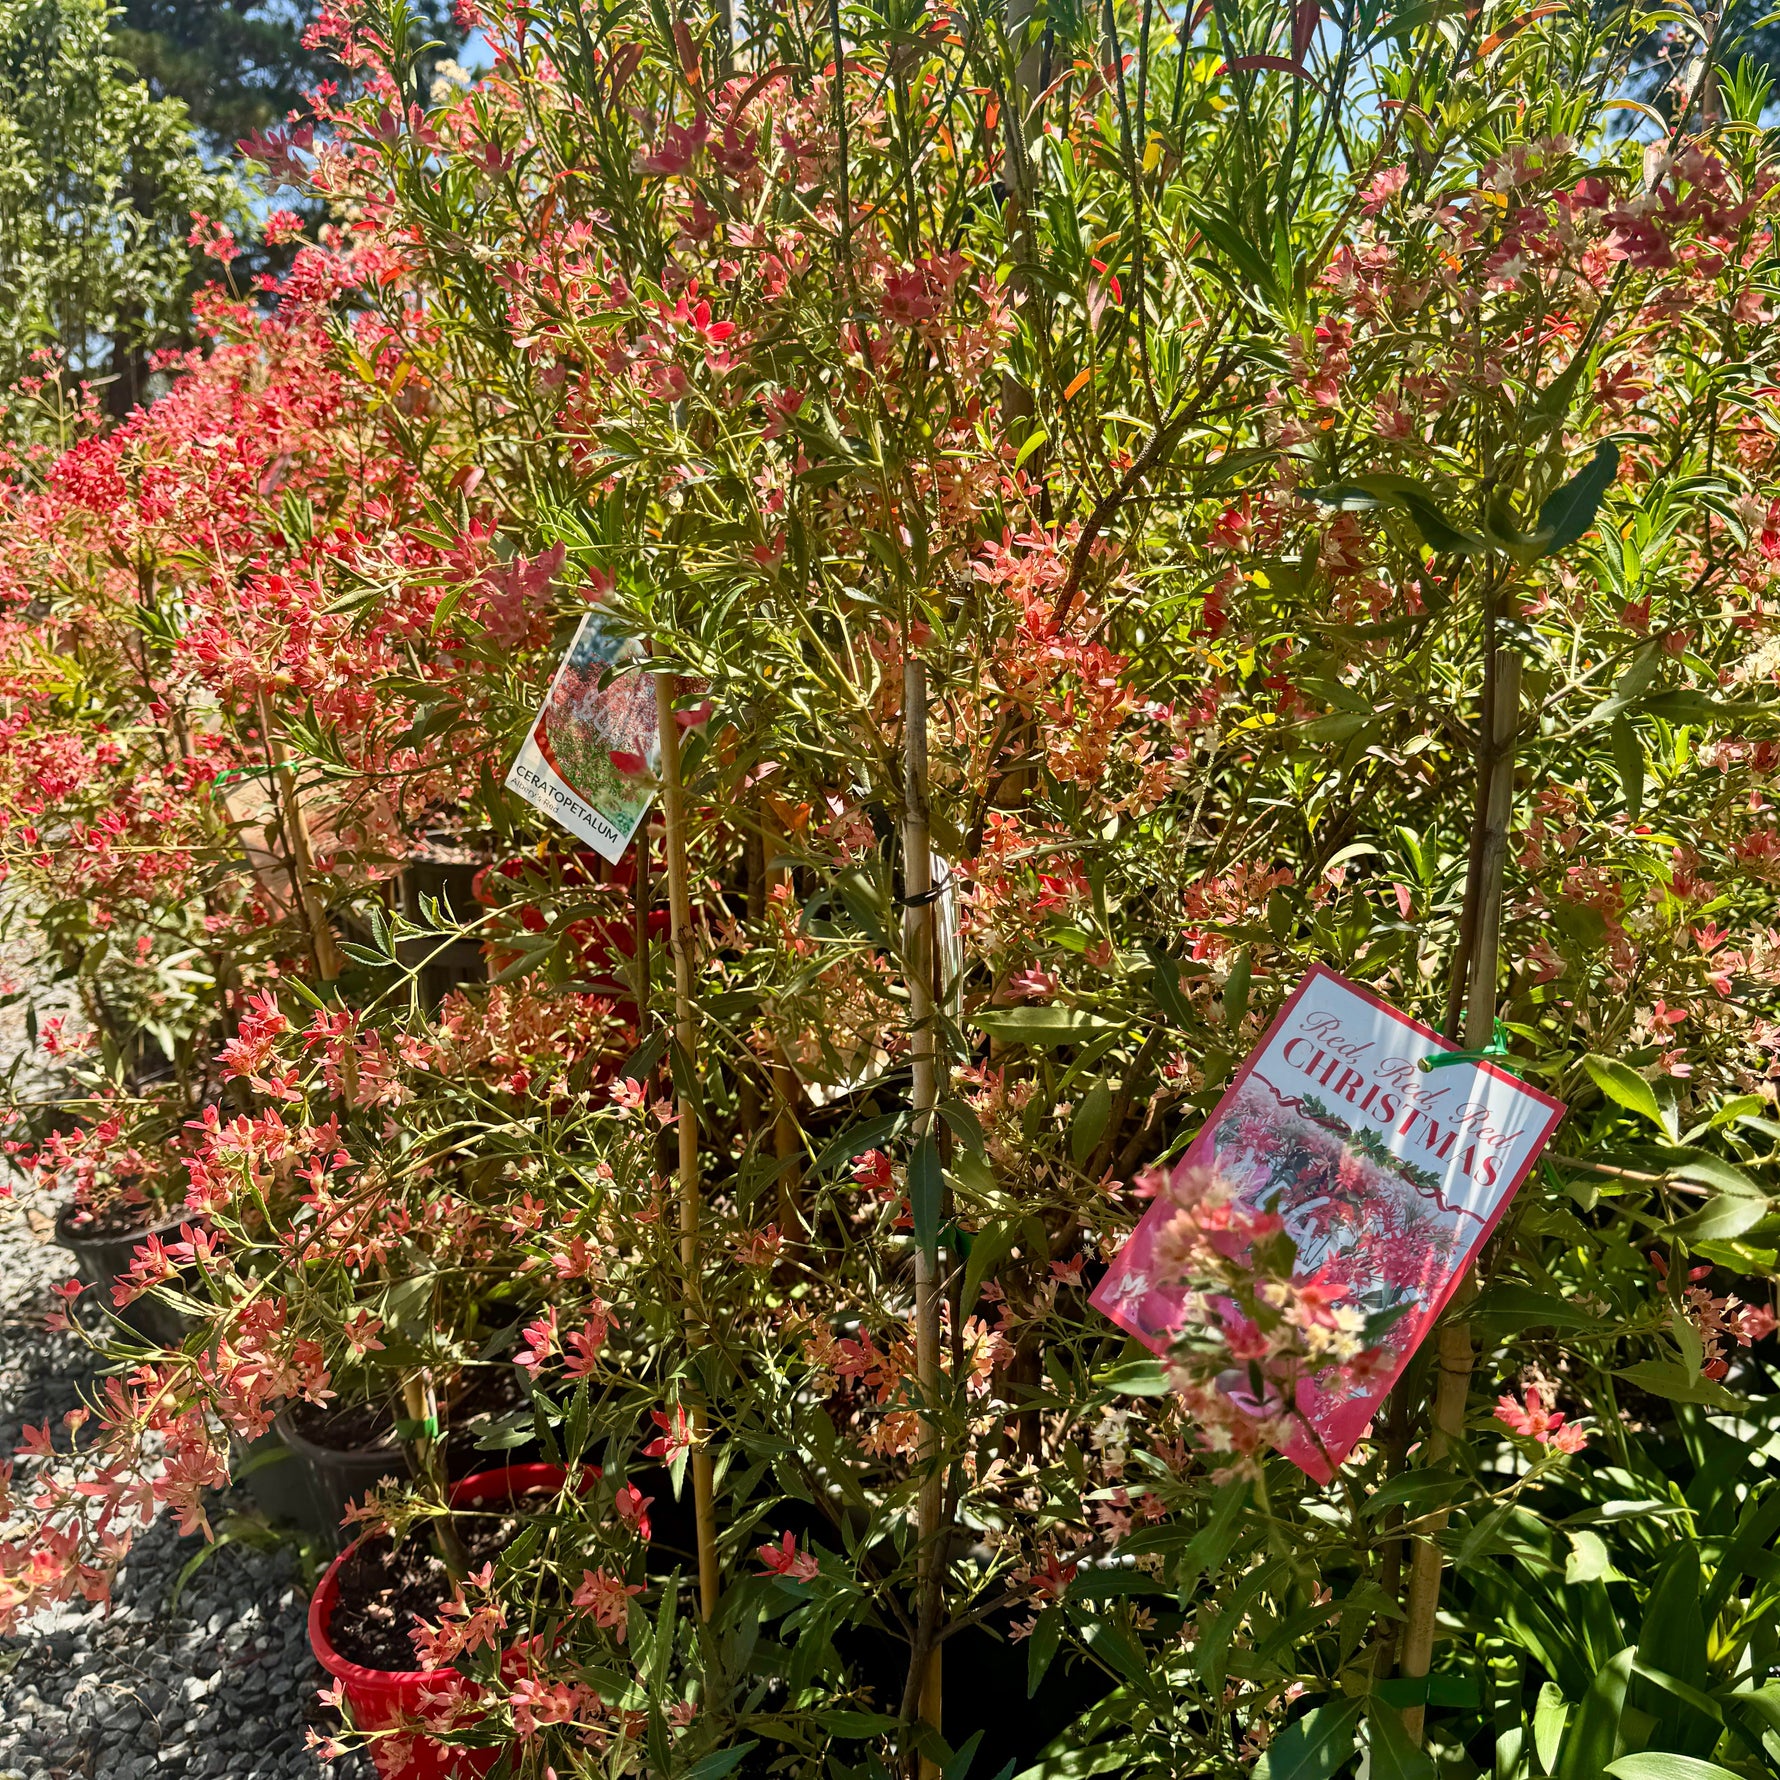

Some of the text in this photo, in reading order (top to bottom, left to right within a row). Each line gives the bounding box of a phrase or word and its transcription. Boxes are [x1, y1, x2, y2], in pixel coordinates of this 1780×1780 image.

[516, 765, 618, 844] CERATOPETALUM
[542, 798, 560, 814] Red
[1283, 1037, 1503, 1187] CHRISTMAS
[1299, 1011, 1525, 1150] Red, Red, Red
